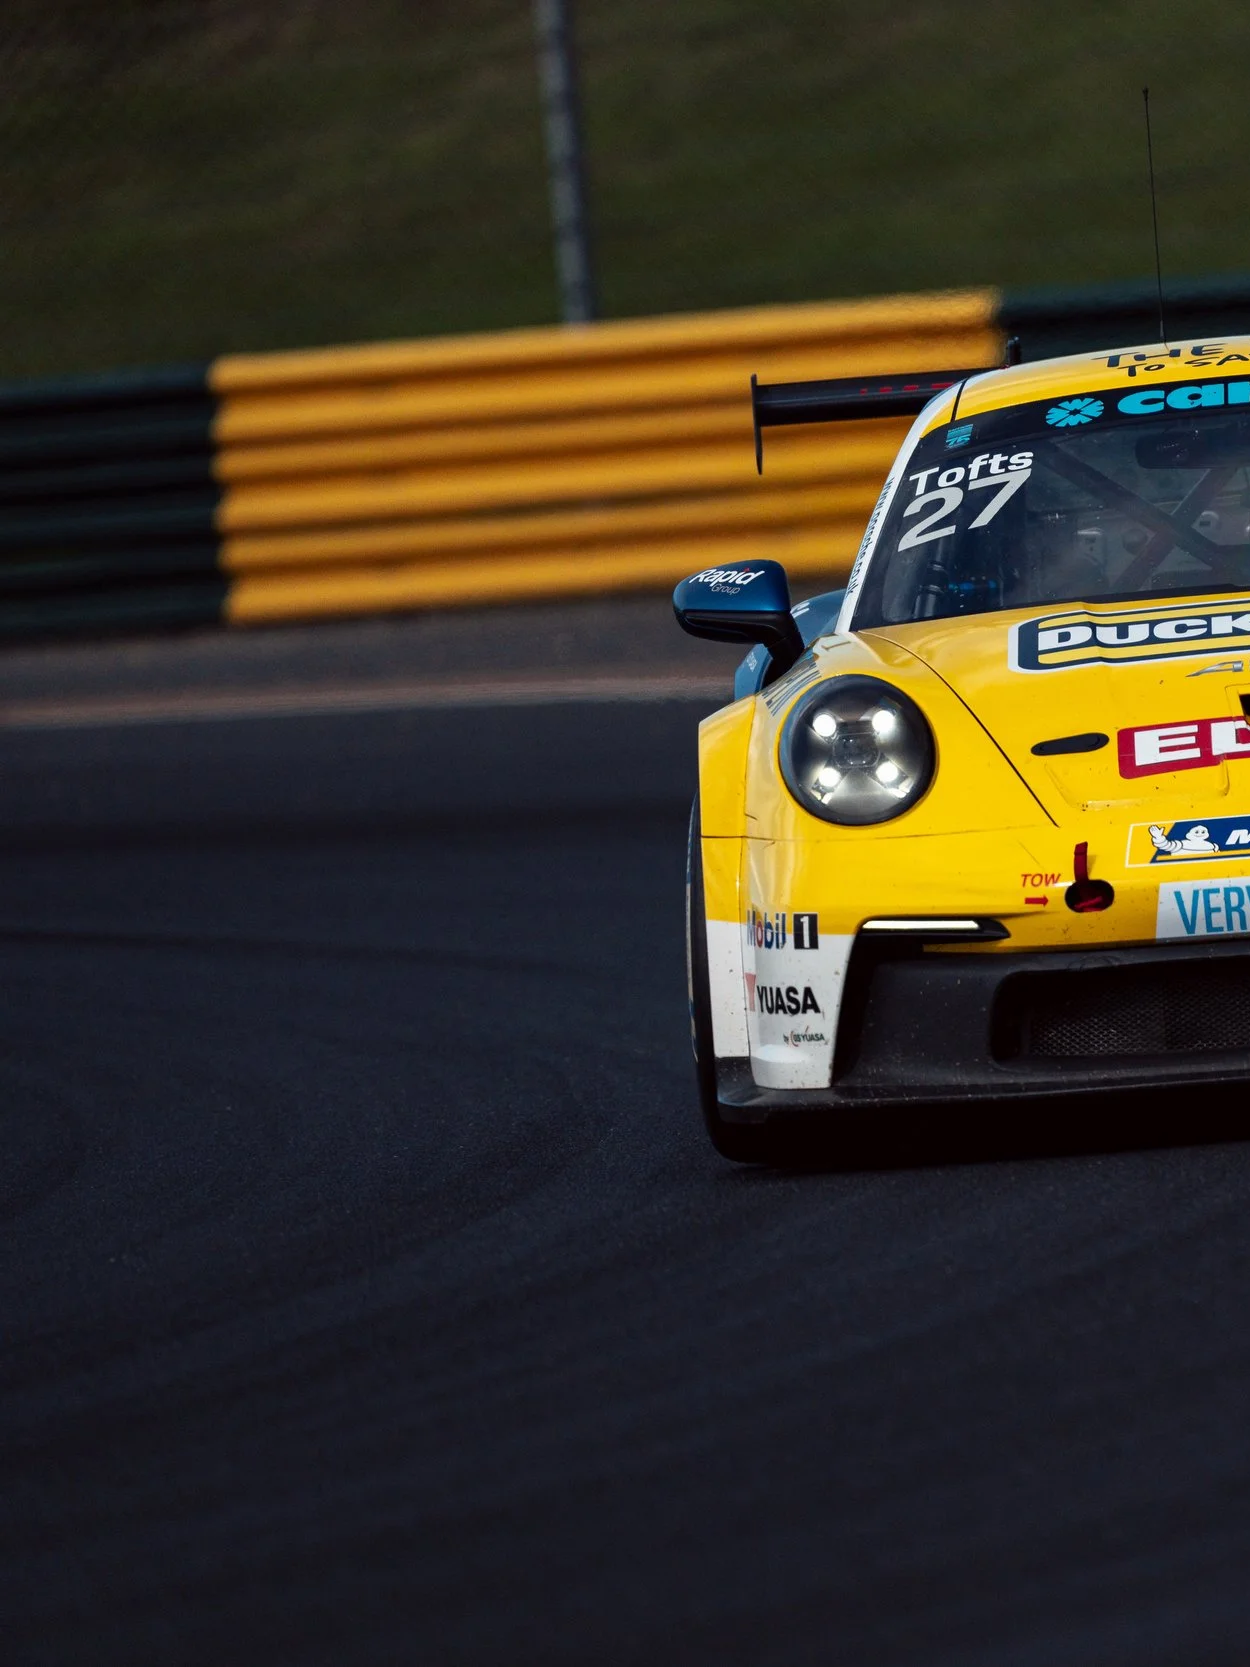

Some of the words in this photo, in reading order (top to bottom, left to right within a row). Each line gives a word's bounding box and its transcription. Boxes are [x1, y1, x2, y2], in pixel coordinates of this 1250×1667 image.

[1091, 342, 1228, 368] THE
[908, 450, 1035, 497] Tofts
[897, 468, 1033, 553] 27
[688, 567, 766, 587] Rapid
[711, 583, 741, 595] Group
[1020, 872, 1062, 889] TOW
[746, 910, 786, 950] Mobil
[756, 985, 821, 1015] YUASA
